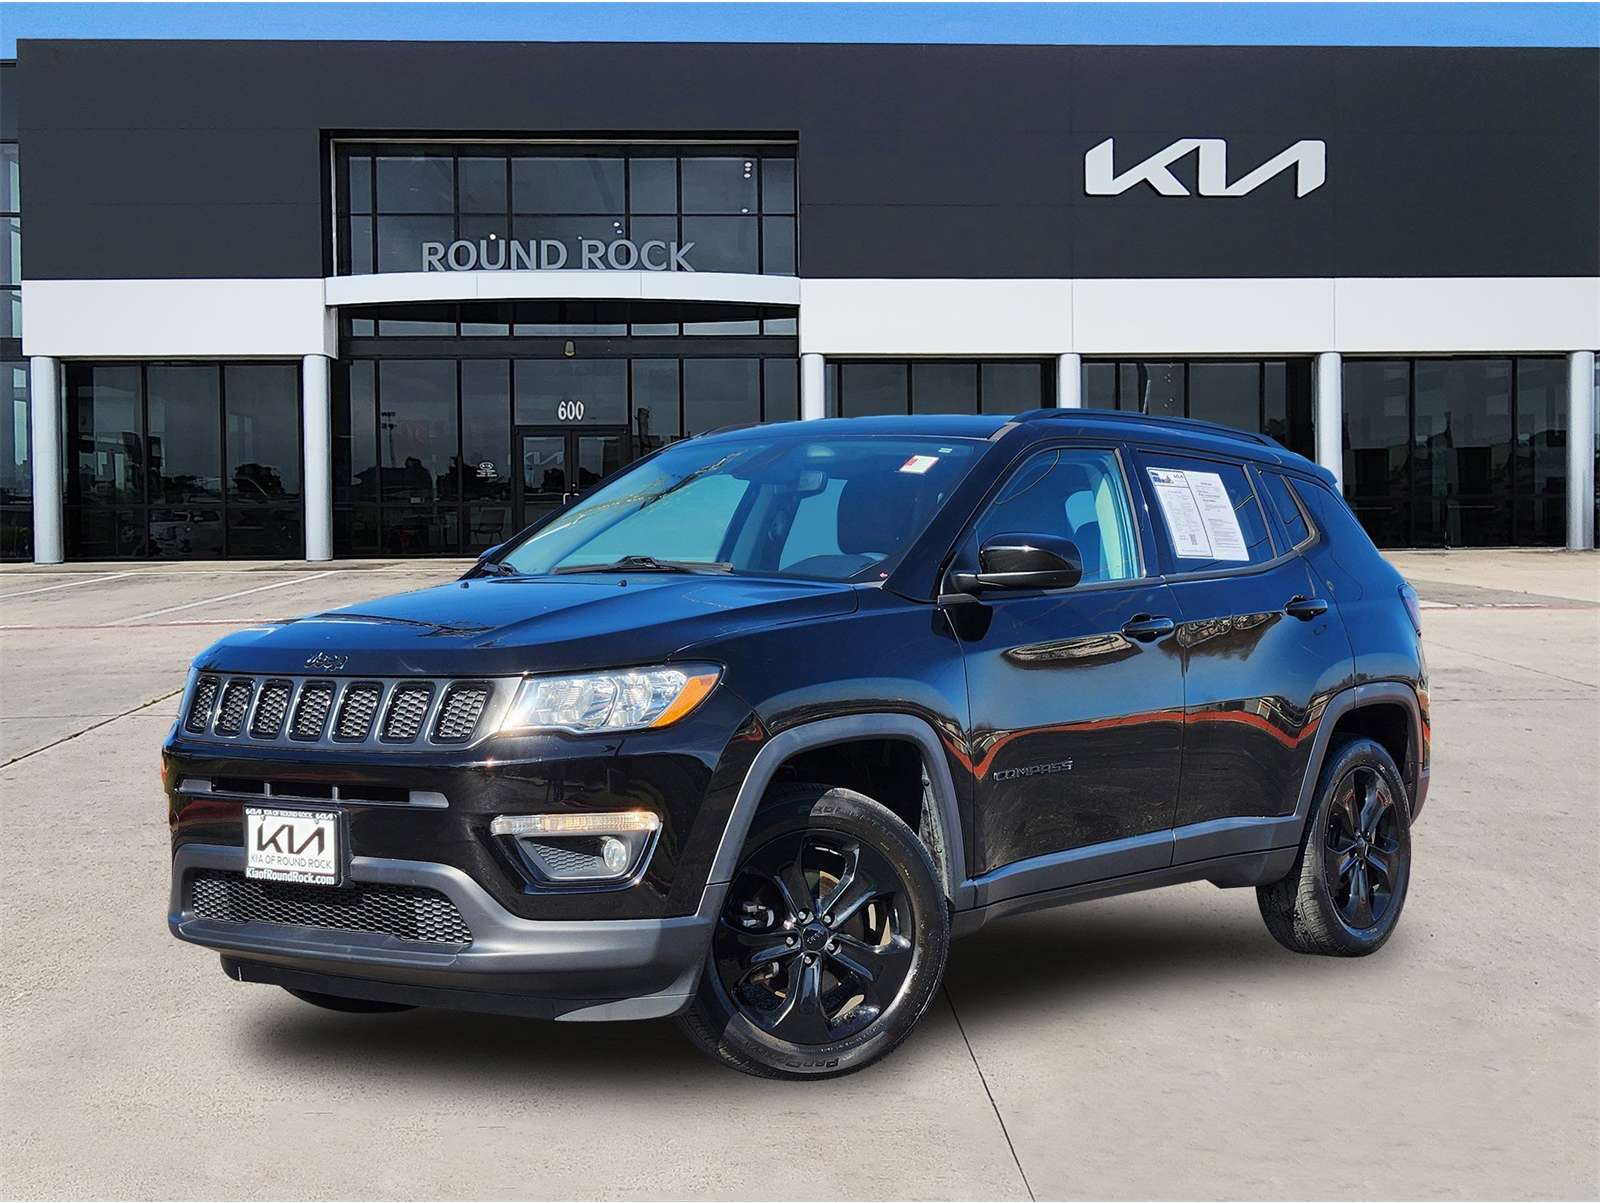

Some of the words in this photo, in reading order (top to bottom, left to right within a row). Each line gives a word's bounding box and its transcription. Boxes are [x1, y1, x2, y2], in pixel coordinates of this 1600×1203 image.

[1085, 138, 1326, 198] KIA
[422, 239, 568, 272] ROUND
[581, 239, 696, 272] ROCK
[557, 400, 585, 421] 600
[993, 759, 1074, 781] COMPASS
[257, 824, 325, 856] KIA
[251, 855, 264, 864] KIA
[265, 855, 276, 865] OF
[277, 856, 308, 868] ROUND
[308, 858, 333, 870] ROCK
